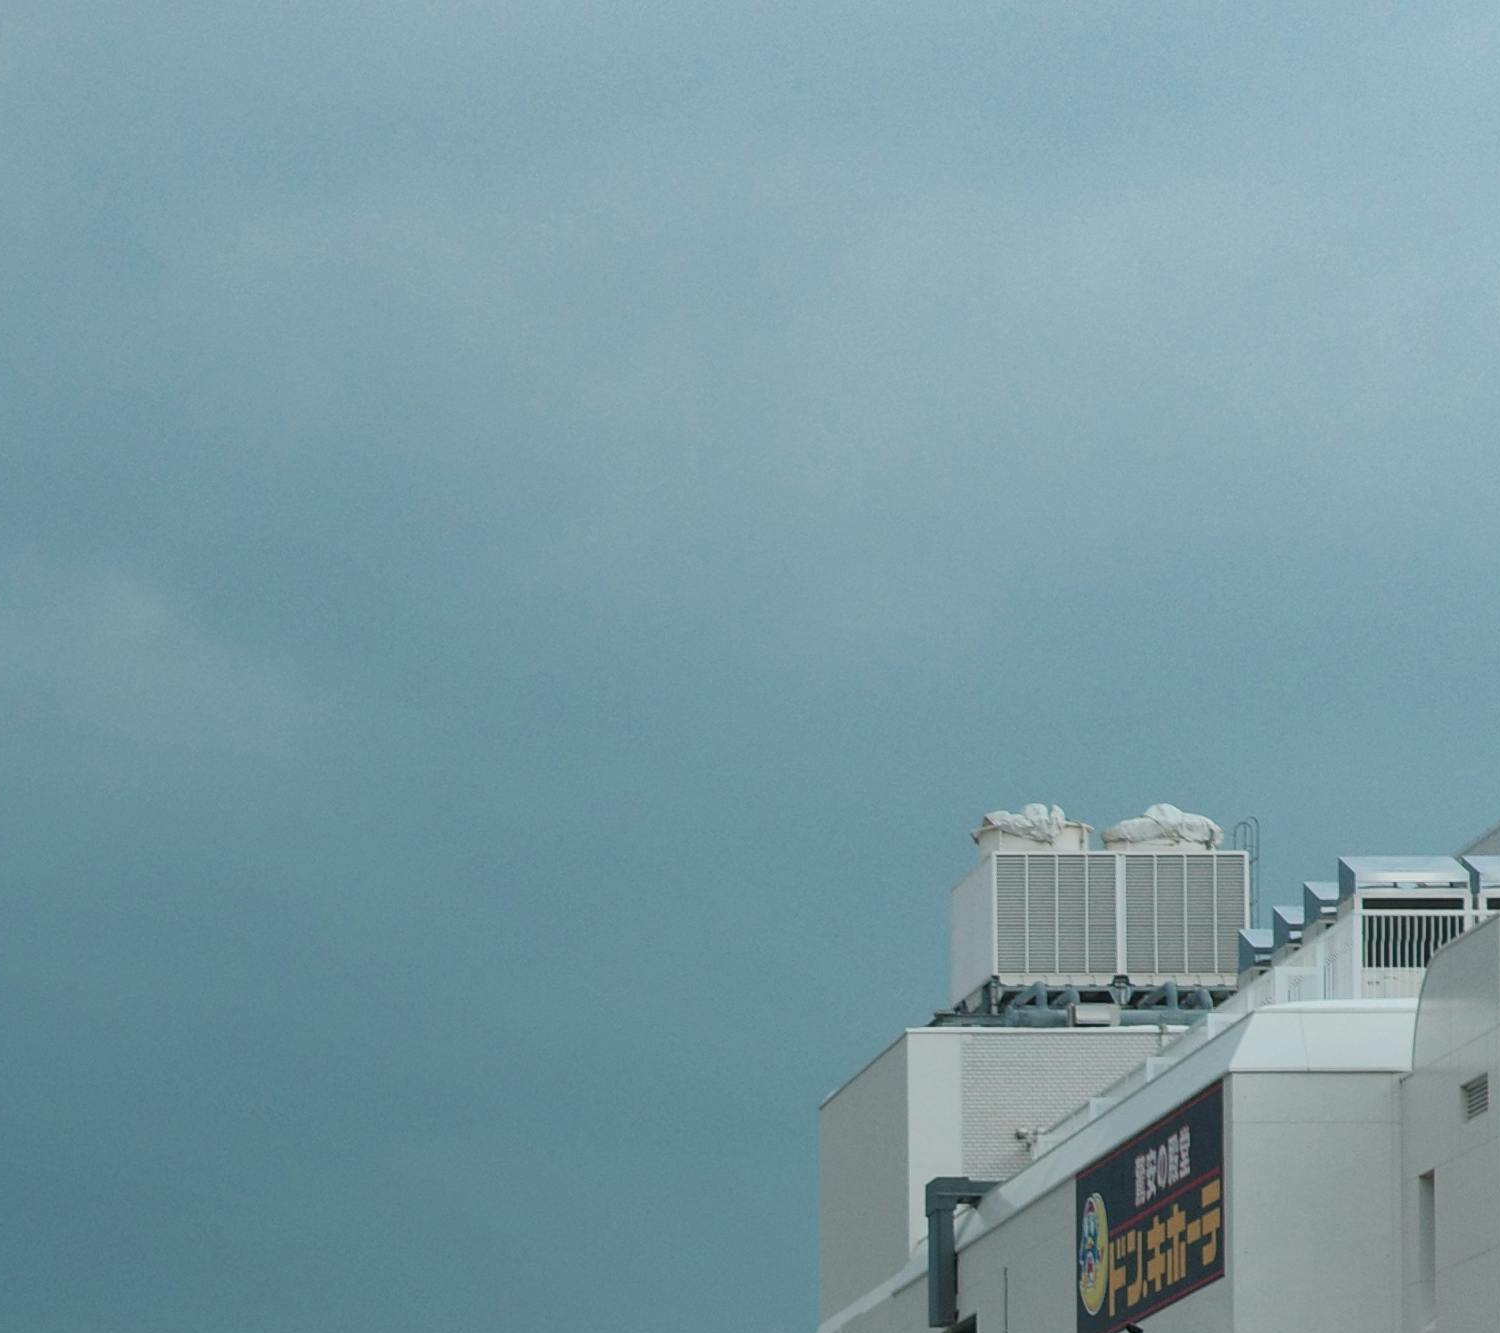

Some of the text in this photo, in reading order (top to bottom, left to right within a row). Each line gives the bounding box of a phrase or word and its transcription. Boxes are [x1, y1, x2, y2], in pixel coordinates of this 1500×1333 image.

[1133, 1124, 1192, 1206] 驚安の殿堂
